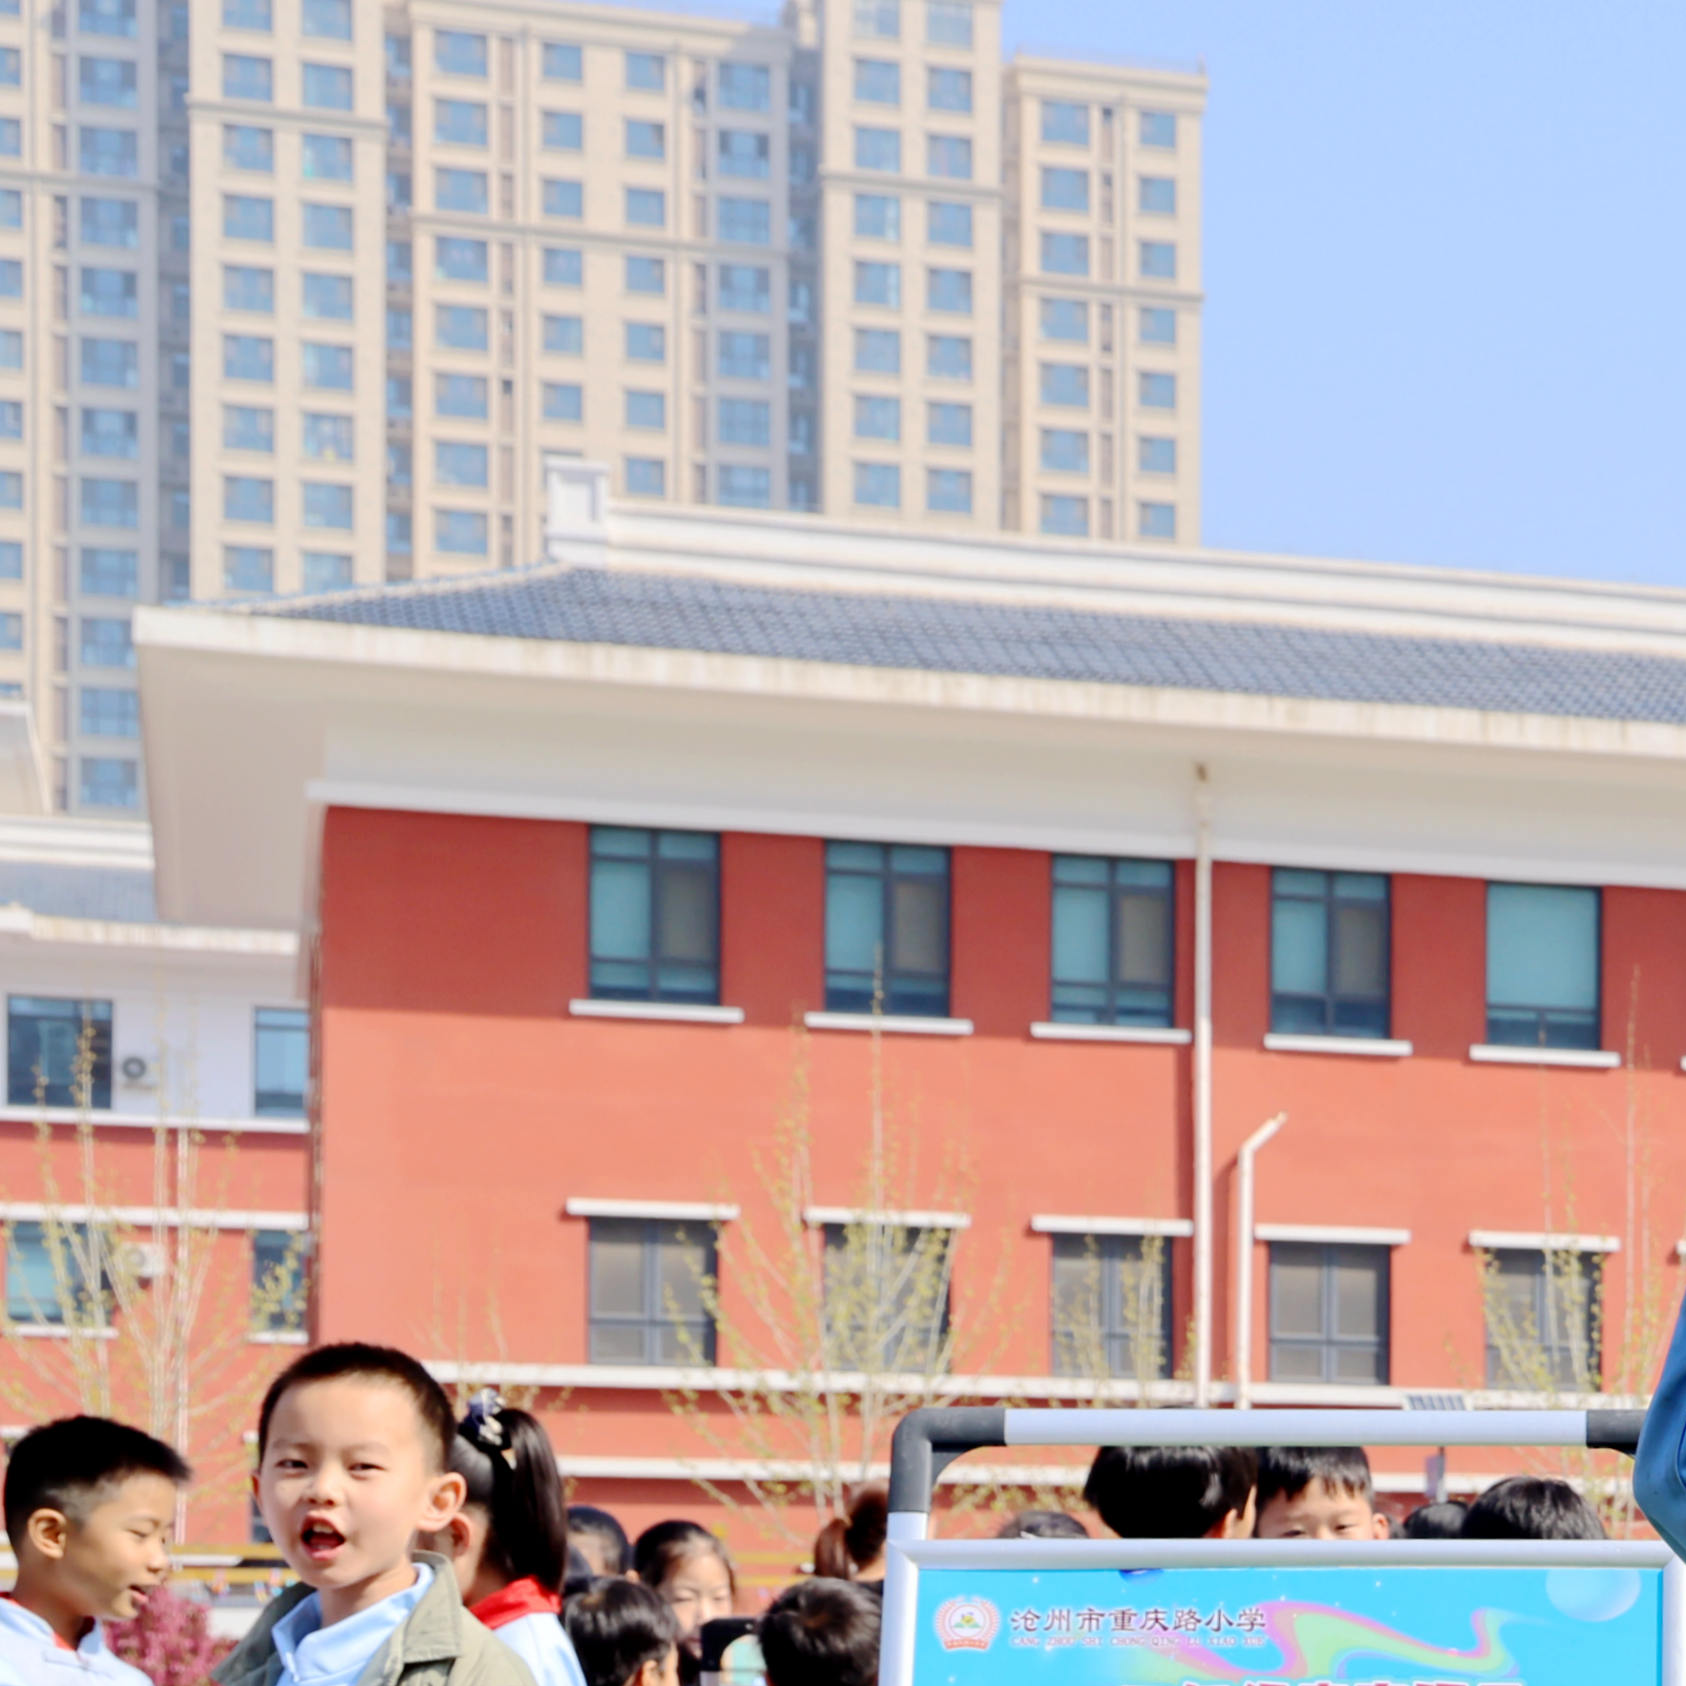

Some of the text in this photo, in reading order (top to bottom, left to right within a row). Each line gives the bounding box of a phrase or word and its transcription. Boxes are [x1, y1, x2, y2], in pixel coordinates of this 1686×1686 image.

[1010, 1608, 1267, 1633] 沧州市重庆路小学
